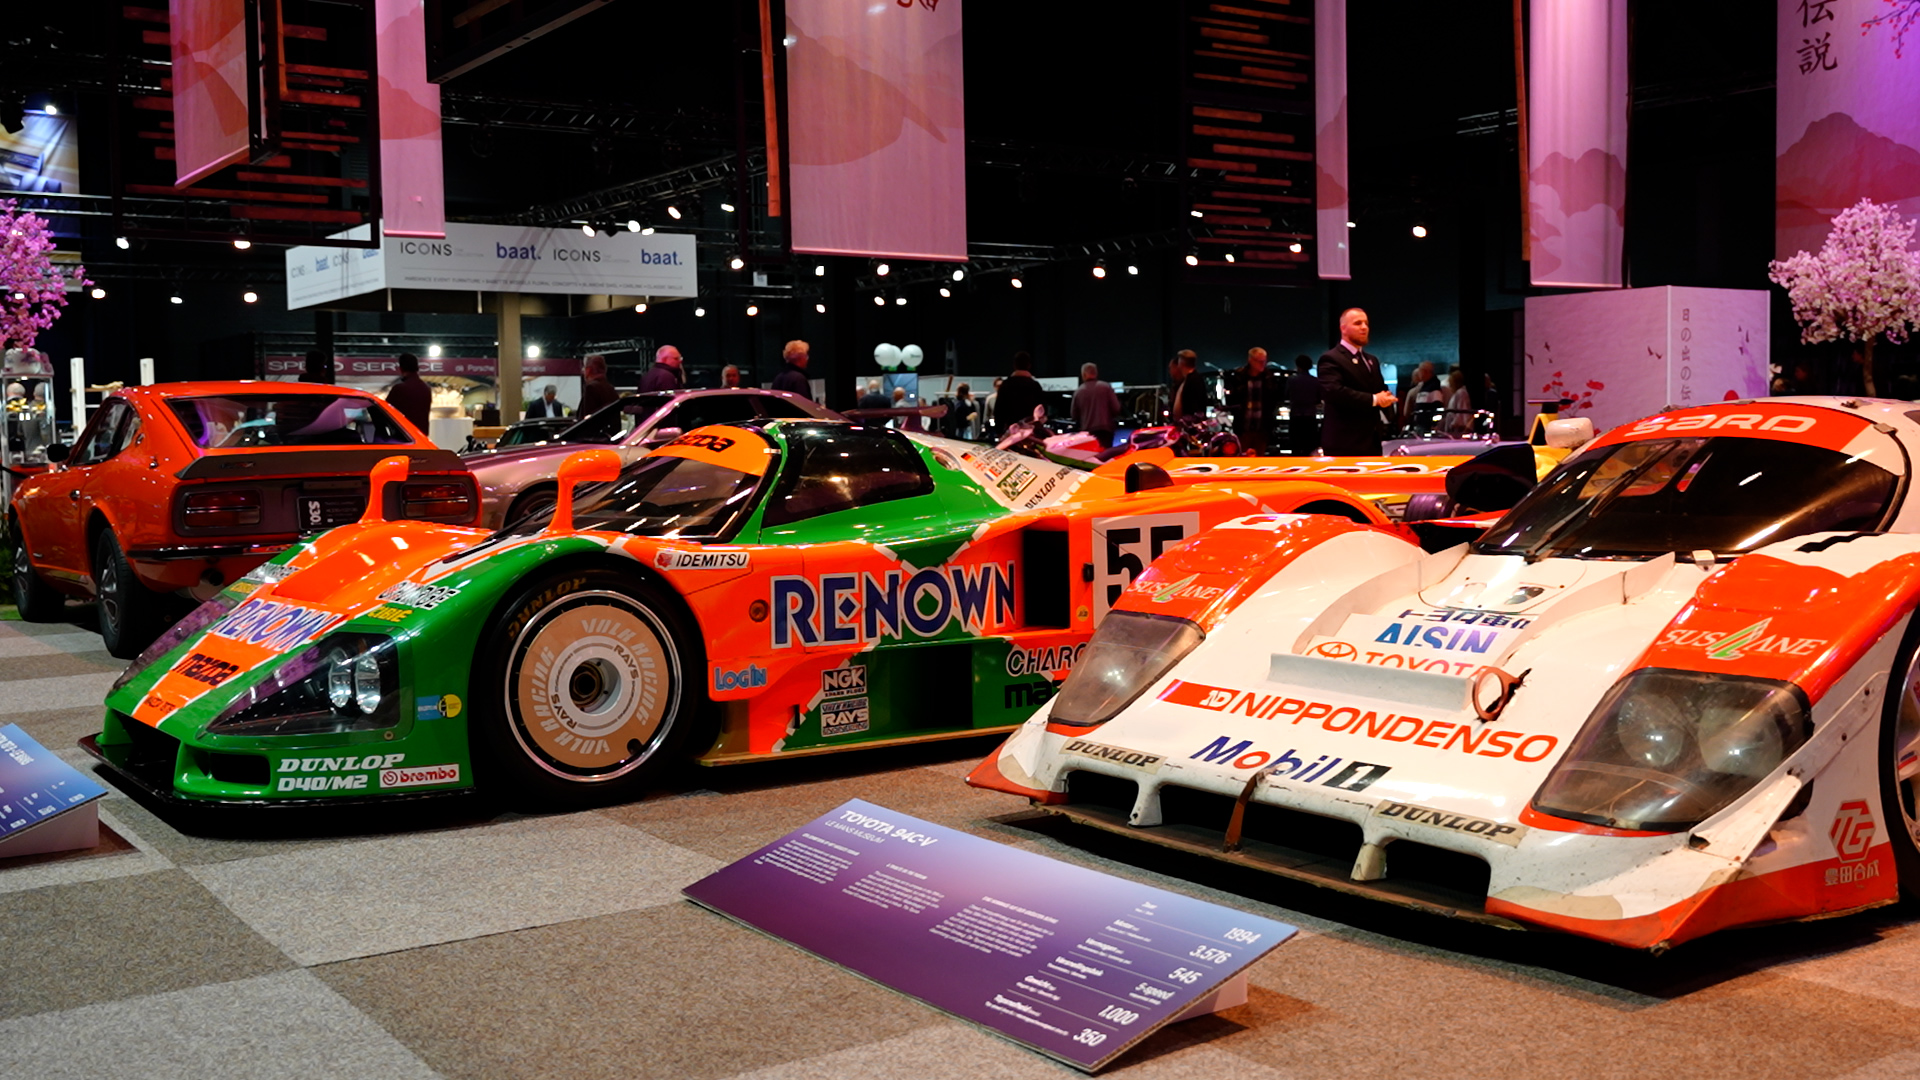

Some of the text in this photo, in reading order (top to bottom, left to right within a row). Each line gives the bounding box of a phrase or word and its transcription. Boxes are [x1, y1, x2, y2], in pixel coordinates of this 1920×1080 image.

[400, 242, 452, 256] ICONS
[496, 242, 541, 260] baat.
[553, 249, 601, 262] ICONS
[641, 249, 683, 265] baat.
[268, 361, 344, 372] SPED
[352, 361, 443, 372] SERCE
[1024, 477, 1056, 509] DUNLOP
[676, 553, 748, 567] IDEMITSU
[772, 561, 1016, 649] RENOWN
[206, 598, 344, 653] RENOWN
[1374, 623, 1498, 653] AISIN
[613, 644, 639, 680] RAYS
[824, 668, 864, 691] NGK
[551, 693, 577, 729] RAYS
[823, 709, 868, 727] RAYS
[1228, 692, 1558, 763] NIPPONDENSO
[277, 753, 405, 772] DUNLOP
[1066, 741, 1160, 767] DUNLOP
[1189, 736, 1343, 783] Mobil
[277, 774, 368, 792] D40/M2
[400, 768, 457, 783] brembo
[839, 810, 938, 847] TOYOTA 94C-V
[1386, 802, 1516, 837] DUNLOP
[834, 823, 855, 834] MANS
[852, 829, 885, 844] MUSEUM
[1223, 926, 1262, 945] 1994
[1189, 945, 1232, 965] 3.576
[1168, 967, 1203, 985] 545
[1097, 1005, 1140, 1026] 1.000
[1073, 1028, 1108, 1047] 350
